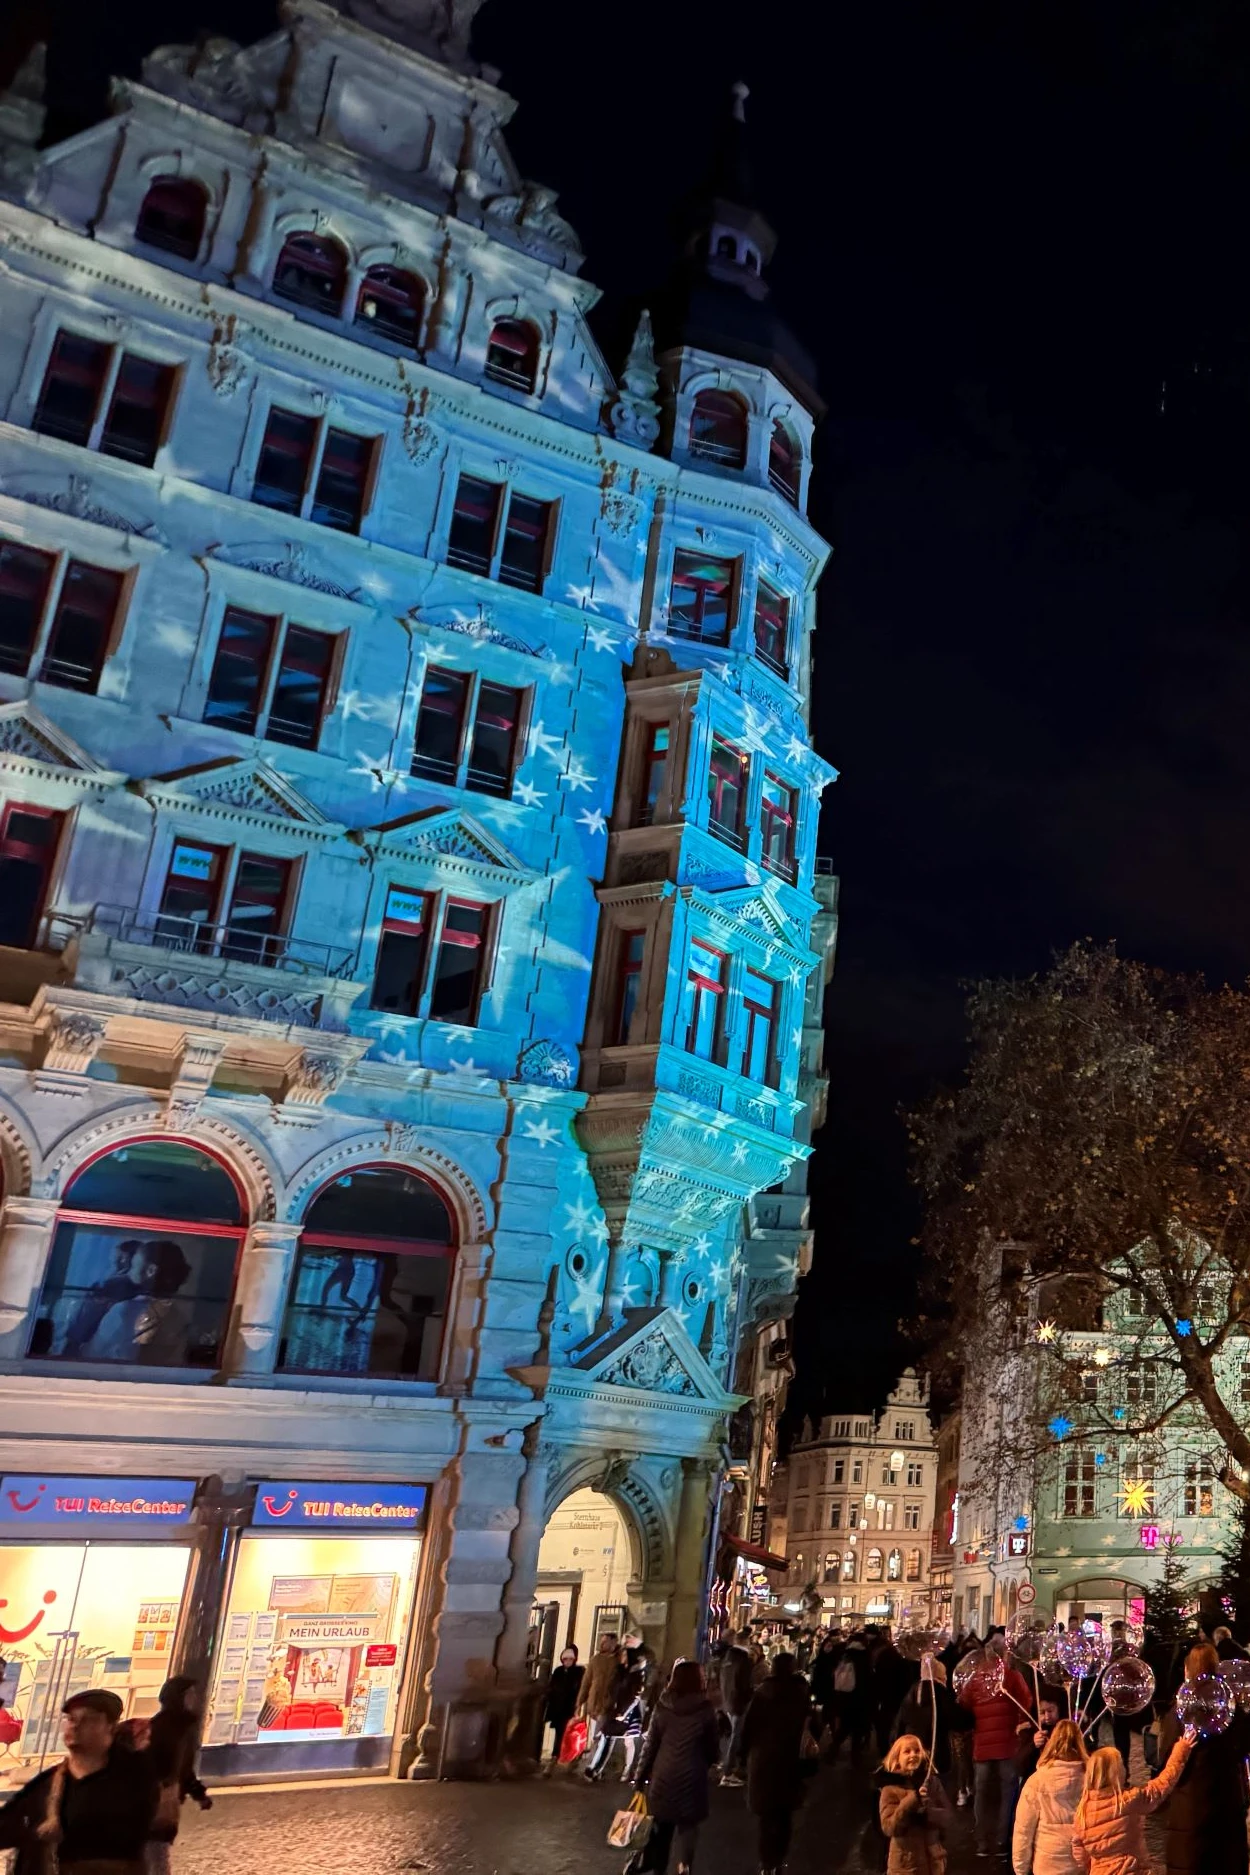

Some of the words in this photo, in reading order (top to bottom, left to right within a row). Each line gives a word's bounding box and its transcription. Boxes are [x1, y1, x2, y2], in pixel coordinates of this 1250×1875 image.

[55, 1497, 85, 1513] TUI
[88, 1498, 186, 1515] ReiseCenter
[304, 1502, 329, 1516] TUI
[333, 1503, 419, 1518] ReiseCenter
[289, 1628, 319, 1638] MEIN
[322, 1627, 370, 1637] URLAUB
